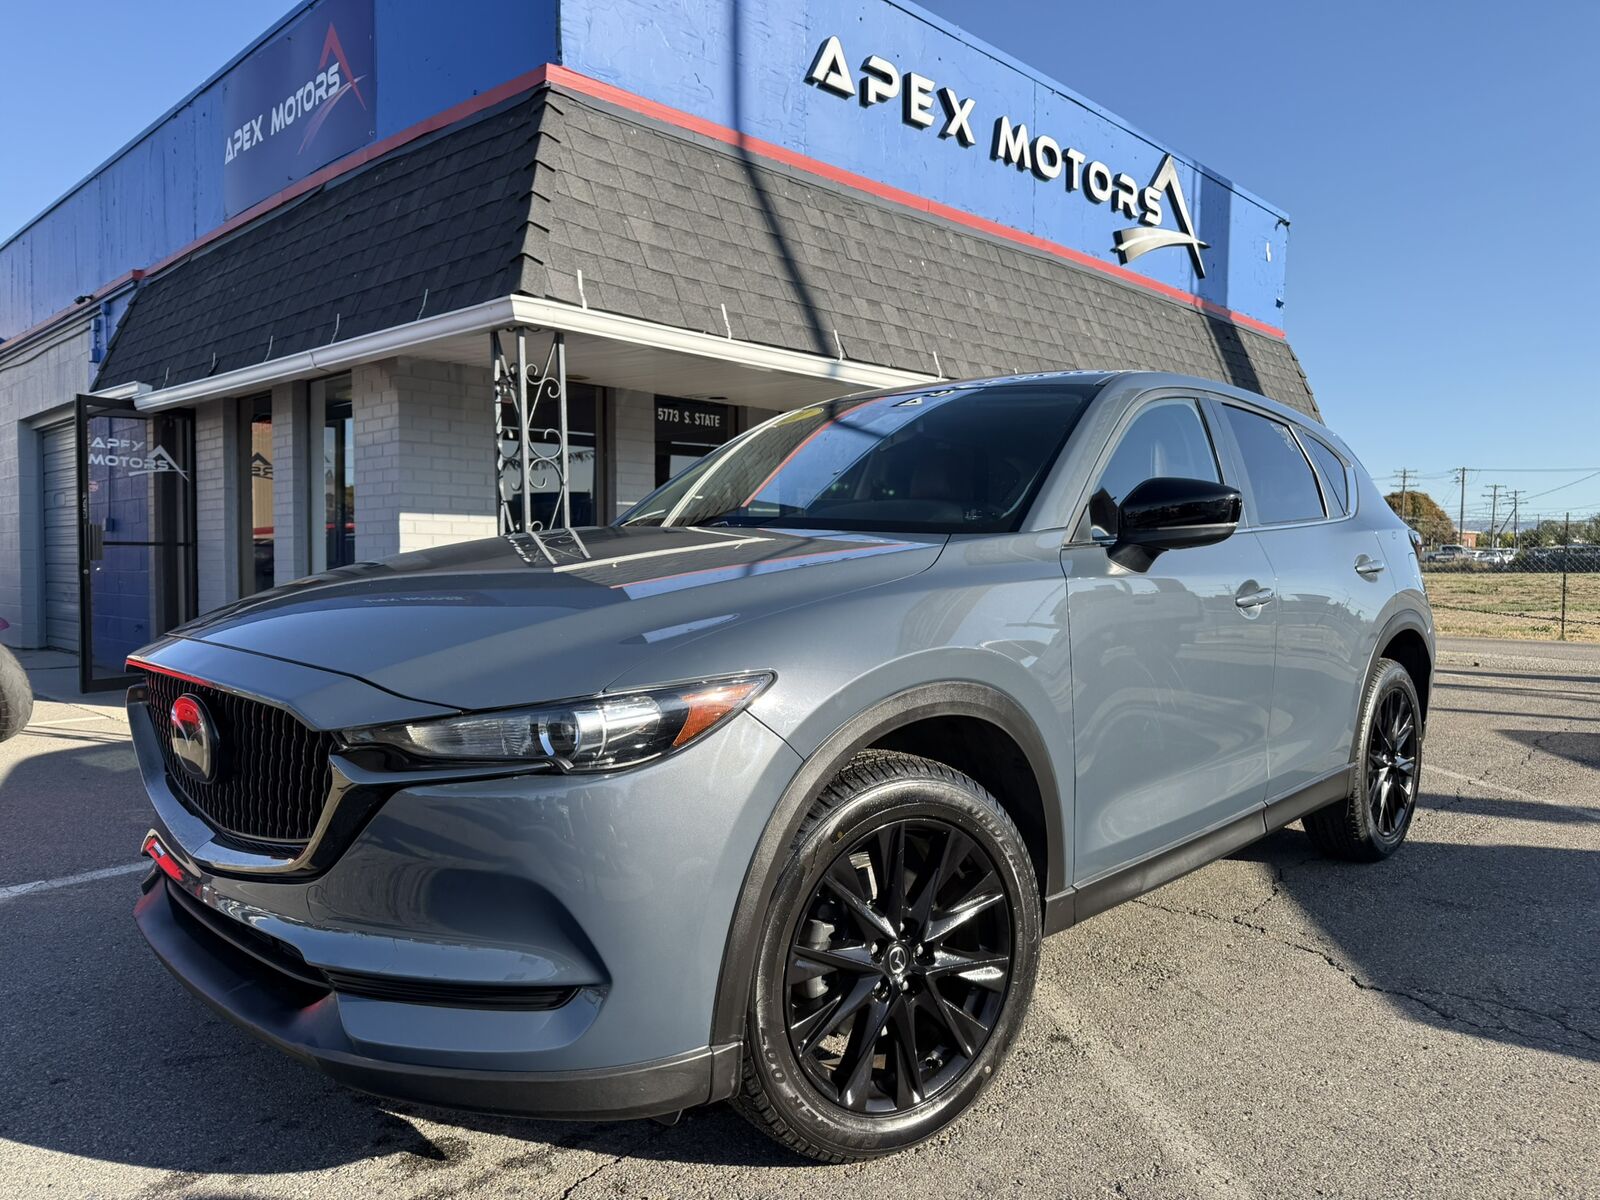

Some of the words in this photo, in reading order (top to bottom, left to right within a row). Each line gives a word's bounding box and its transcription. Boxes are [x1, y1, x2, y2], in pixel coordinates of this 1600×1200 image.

[224, 114, 264, 165] APEX
[270, 62, 340, 136] MOTORS
[804, 35, 977, 148] APEX
[990, 115, 1163, 226] MOTORS
[657, 408, 679, 422] 5773
[684, 411, 692, 424] S.
[694, 413, 720, 427] STATE
[88, 454, 169, 471] MOTORS
